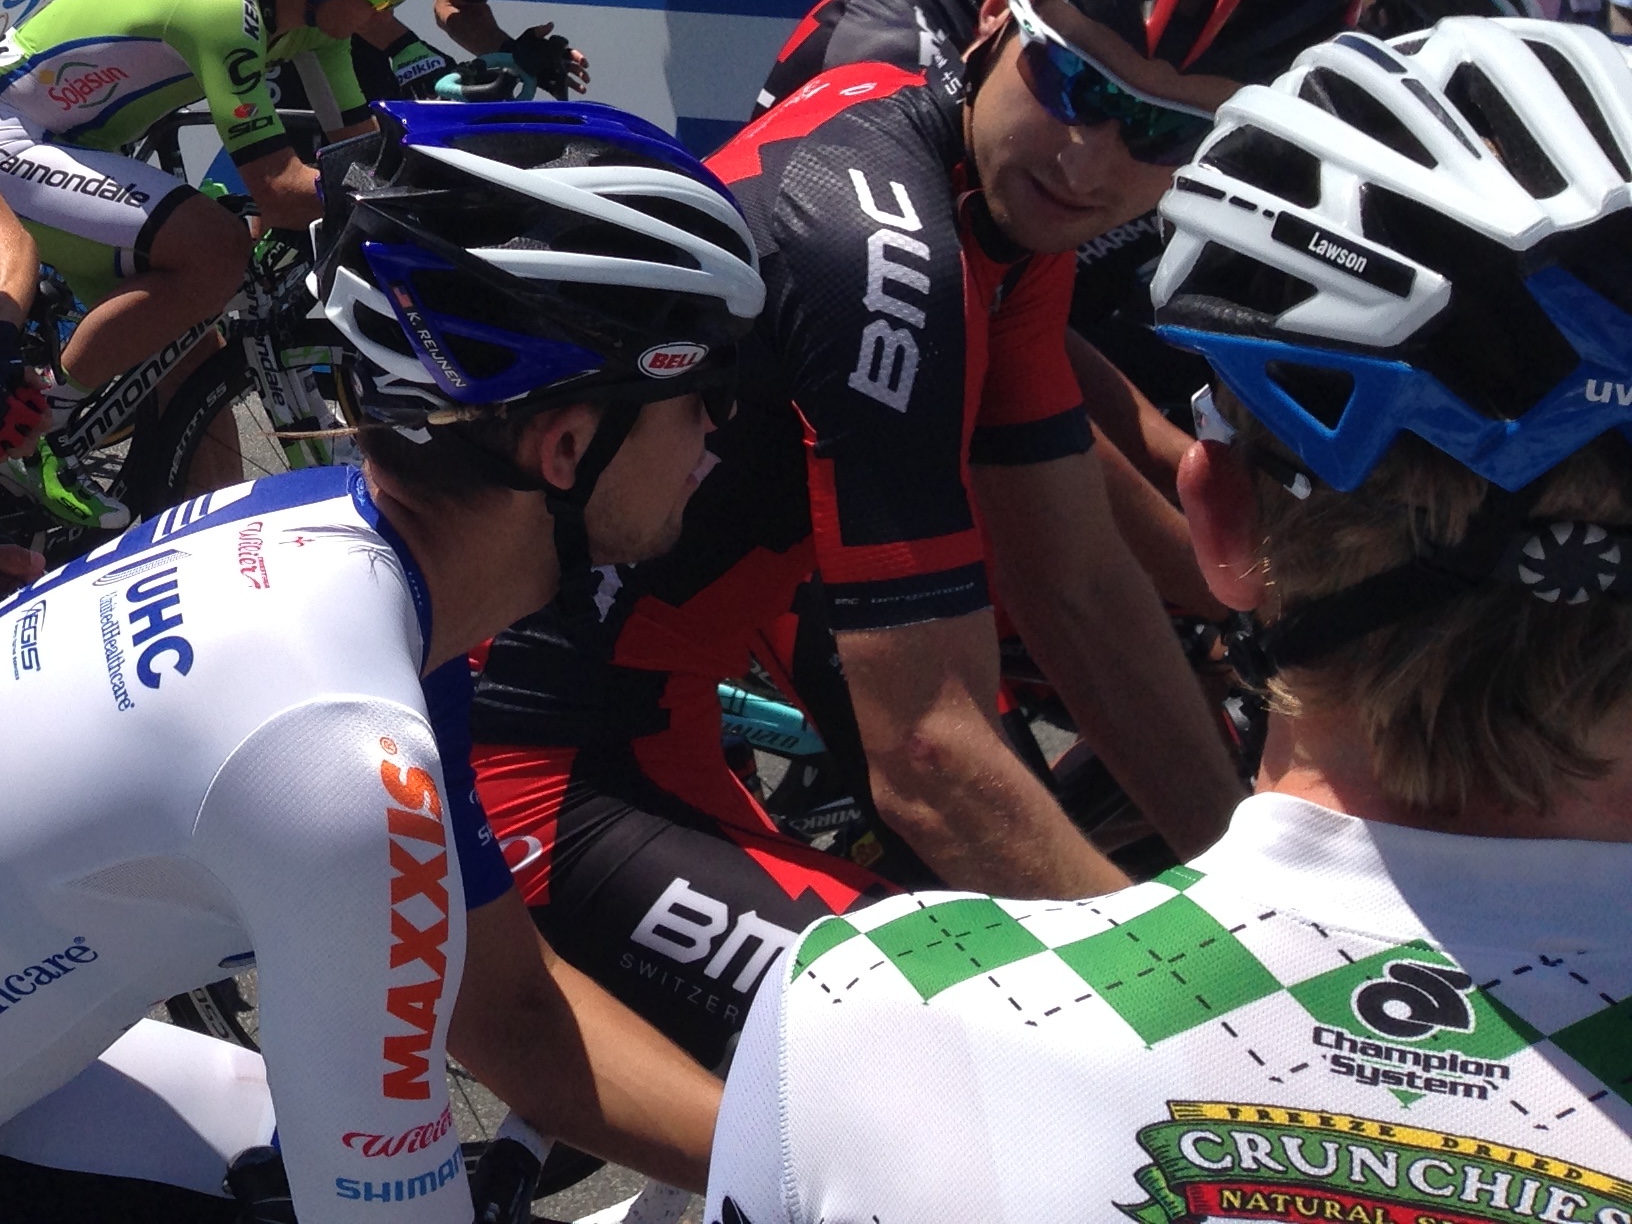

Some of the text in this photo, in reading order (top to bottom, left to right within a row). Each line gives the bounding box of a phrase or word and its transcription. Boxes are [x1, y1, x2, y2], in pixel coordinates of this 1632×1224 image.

[48, 65, 129, 112] Sojasun
[227, 114, 276, 141] SIDI
[1308, 230, 1368, 275] Lawson
[848, 169, 931, 413] BMC
[407, 311, 467, 389] K. REIJNEN
[648, 351, 699, 370] BELL
[1585, 378, 1632, 407] uv
[125, 565, 194, 690] UHC
[379, 738, 449, 1101] MAXXIS
[630, 876, 802, 994] BM
[620, 951, 740, 1021] SWITZER
[1312, 1026, 1511, 1080] Champion
[1329, 1054, 1492, 1100] System
[1226, 1106, 1584, 1180] FREEZE DRIED
[335, 1145, 464, 1202] SHIMAN
[1219, 1188, 1396, 1224] NATURAL
